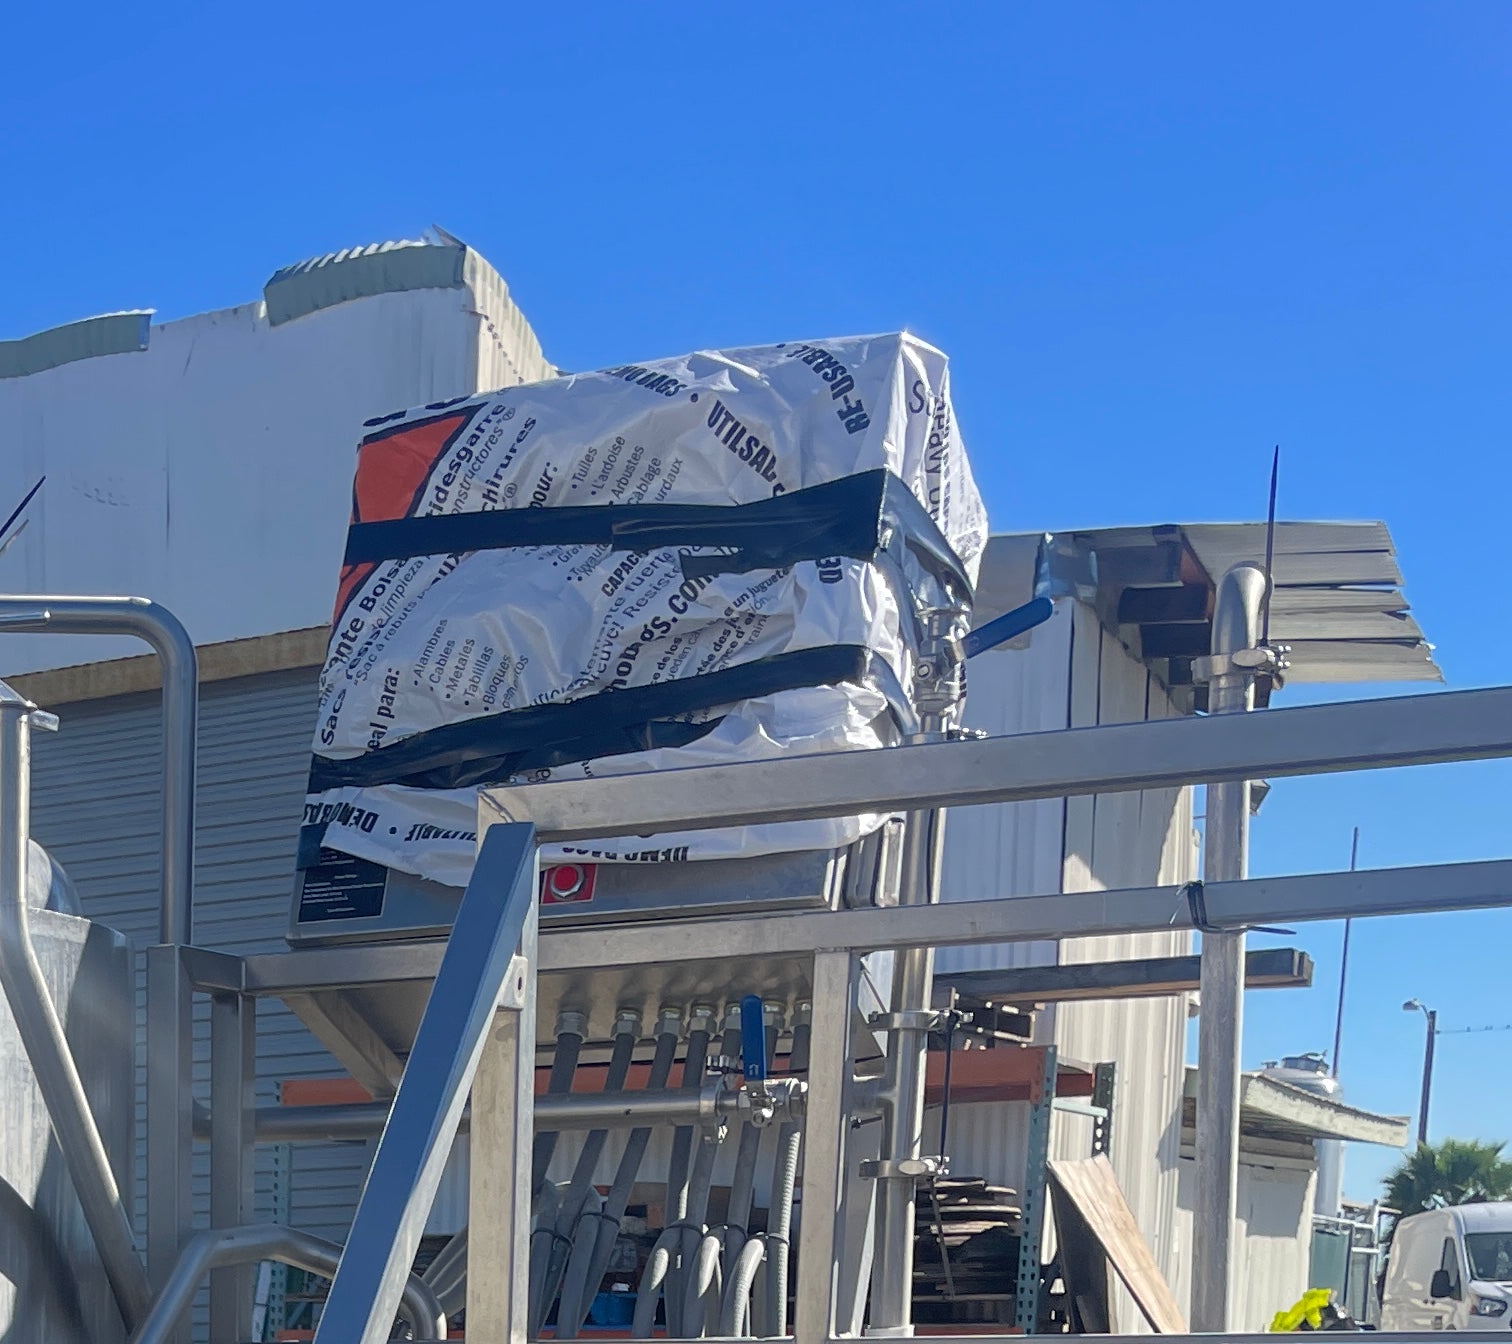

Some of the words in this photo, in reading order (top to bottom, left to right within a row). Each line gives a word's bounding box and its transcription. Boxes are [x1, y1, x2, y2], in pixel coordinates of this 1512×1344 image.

[611, 445, 645, 499] Arbustes
[414, 618, 448, 678] Alambres
[429, 639, 456, 684] Cables
[447, 638, 475, 692] Metales
[377, 667, 400, 719] para:
